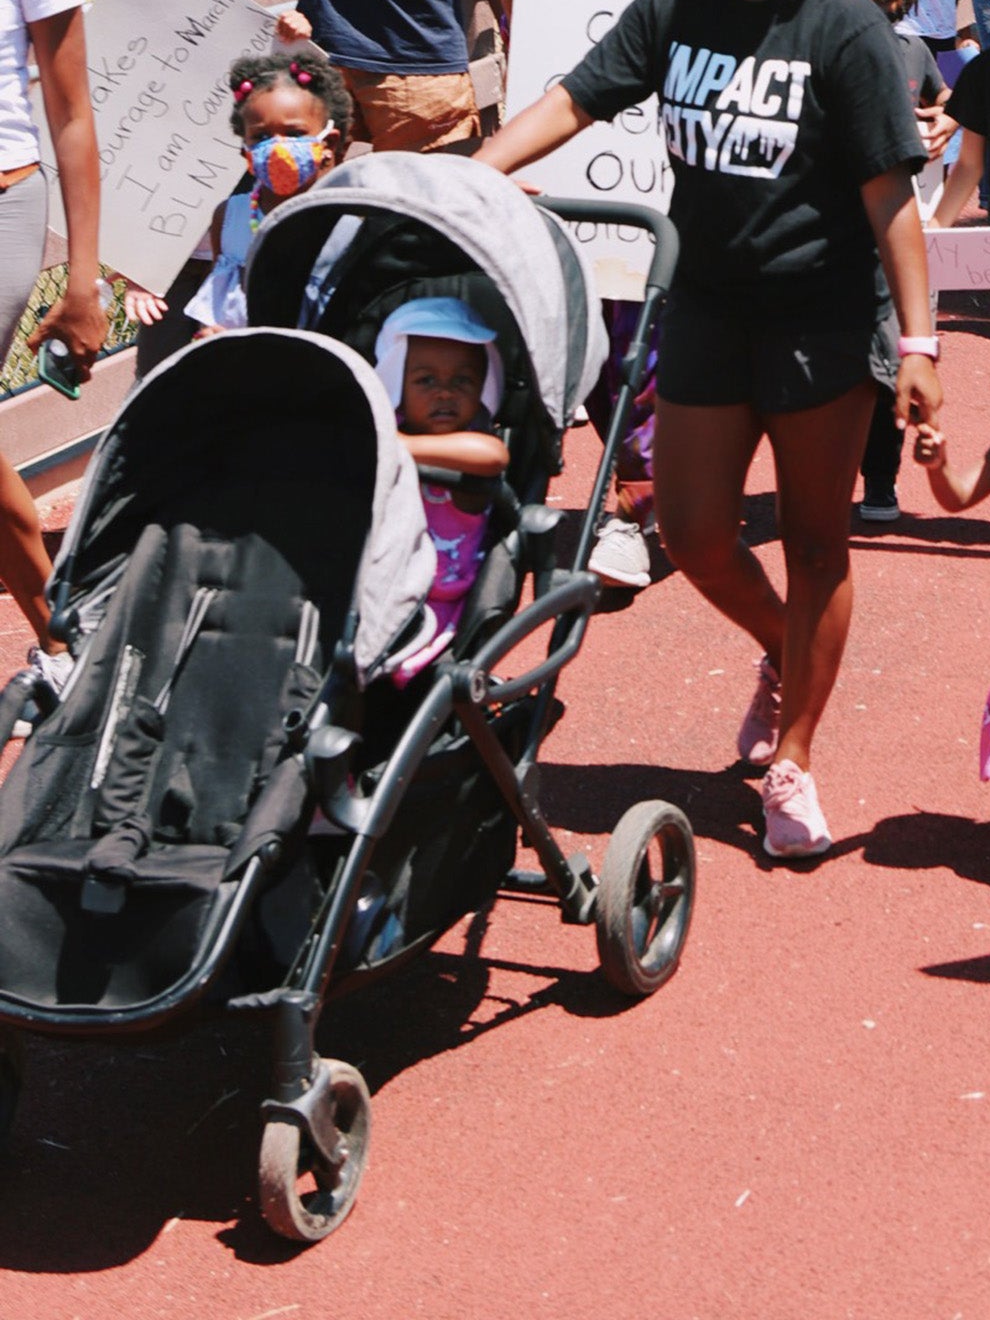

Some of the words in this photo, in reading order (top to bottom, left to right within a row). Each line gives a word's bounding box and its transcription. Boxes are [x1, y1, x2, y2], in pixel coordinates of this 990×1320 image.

[87, 34, 148, 112] akes
[663, 40, 812, 121] MPACT
[98, 79, 172, 183] ourage
